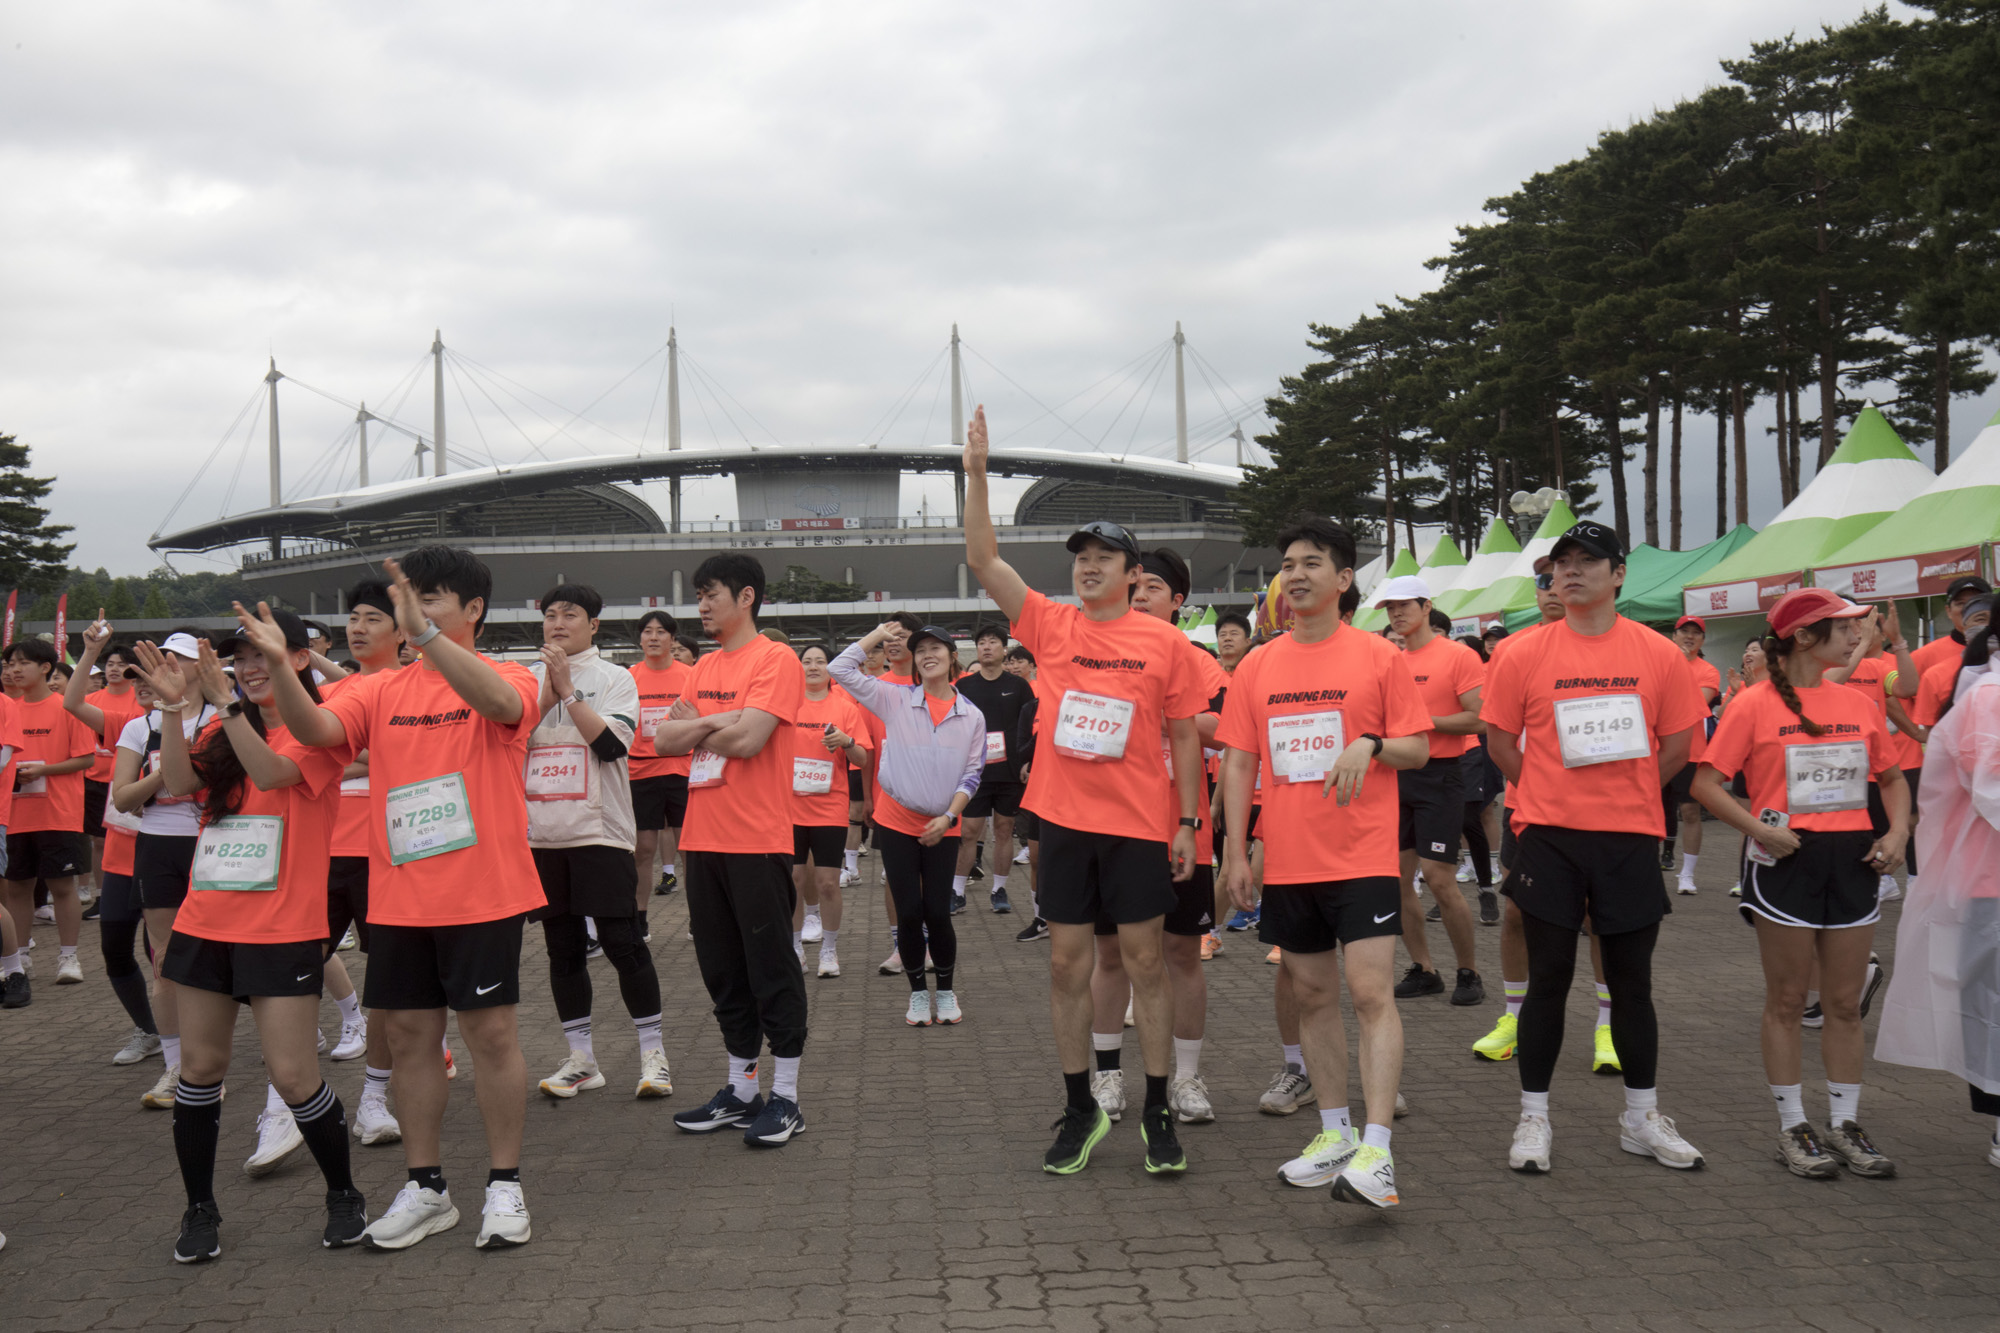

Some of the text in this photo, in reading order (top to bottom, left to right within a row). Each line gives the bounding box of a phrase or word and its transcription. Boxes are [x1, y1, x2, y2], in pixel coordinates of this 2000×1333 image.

[1072, 656, 1147, 671] BURNING RUN
[1554, 677, 1639, 690] BURNING RUN
[1067, 695, 1094, 705] BURNING
[1268, 691, 1320, 706] BURNING
[1320, 690, 1348, 701] RUN
[388, 714, 443, 727] BURNING
[443, 709, 472, 723] RUN
[1064, 714, 1122, 735] M 2107
[1272, 720, 1301, 729] BURNING
[1569, 717, 1634, 735] M 5149
[1779, 724, 1861, 736] BURNG RUN
[1276, 735, 1336, 753] M 2106
[532, 765, 577, 778] M 2341
[799, 771, 827, 782] 3498
[1797, 767, 1858, 783] W 6121
[414, 786, 430, 796] RUN
[442, 781, 456, 789] 7km
[392, 802, 457, 830] M 7289
[204, 843, 268, 858] W 8228
[1314, 1161, 1330, 1170] new
